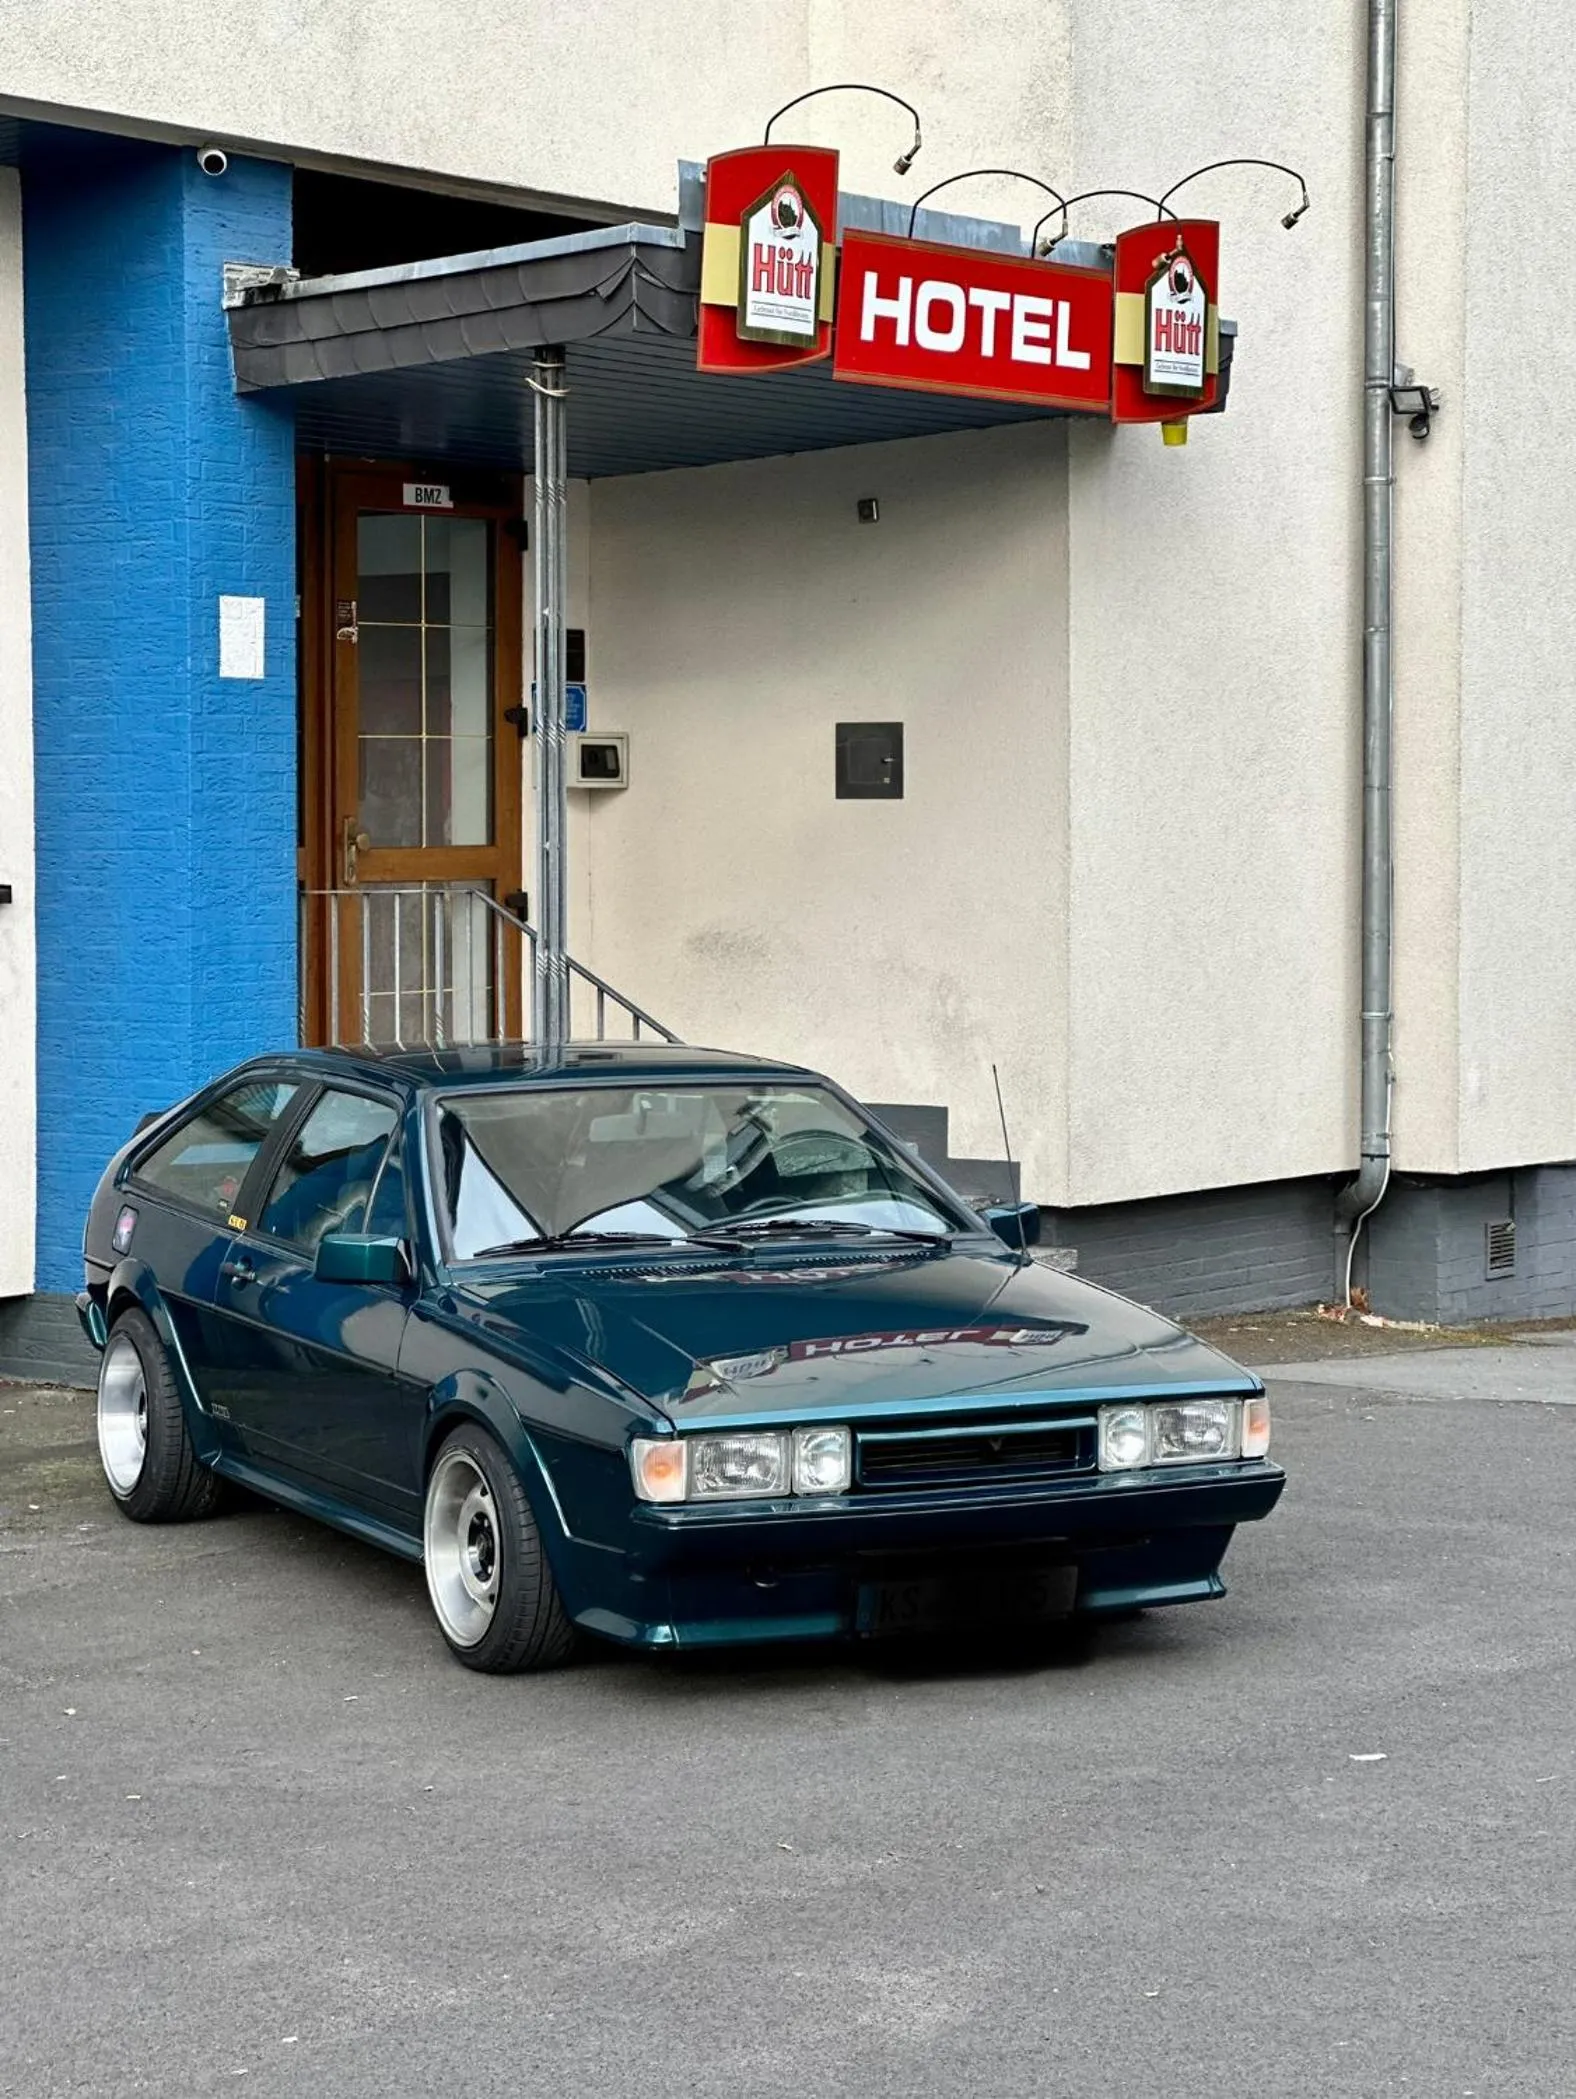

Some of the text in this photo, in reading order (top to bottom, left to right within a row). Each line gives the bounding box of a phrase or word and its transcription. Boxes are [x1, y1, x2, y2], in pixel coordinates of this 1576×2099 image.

[752, 242, 814, 300] Hütt
[860, 270, 1091, 370] HOTEL
[1154, 308, 1202, 356] Hütt
